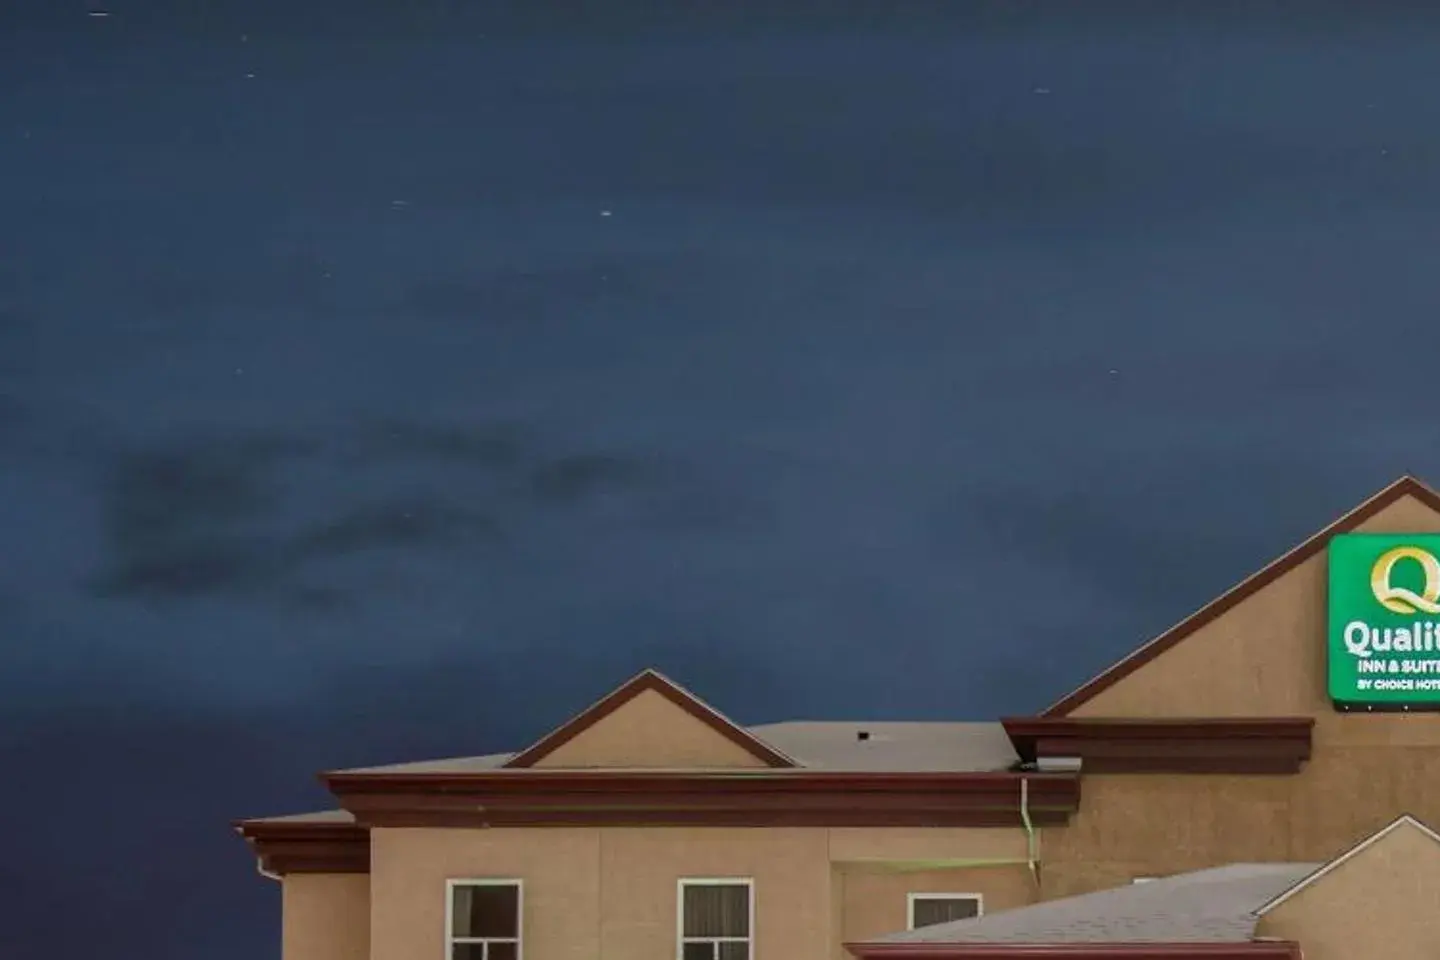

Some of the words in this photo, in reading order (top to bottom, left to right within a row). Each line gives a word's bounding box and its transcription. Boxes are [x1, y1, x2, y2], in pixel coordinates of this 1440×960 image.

[1358, 659, 1386, 673] INN
[1388, 660, 1400, 673] &
[1357, 679, 1372, 690] BY
[1374, 679, 1414, 690] CHOICE
